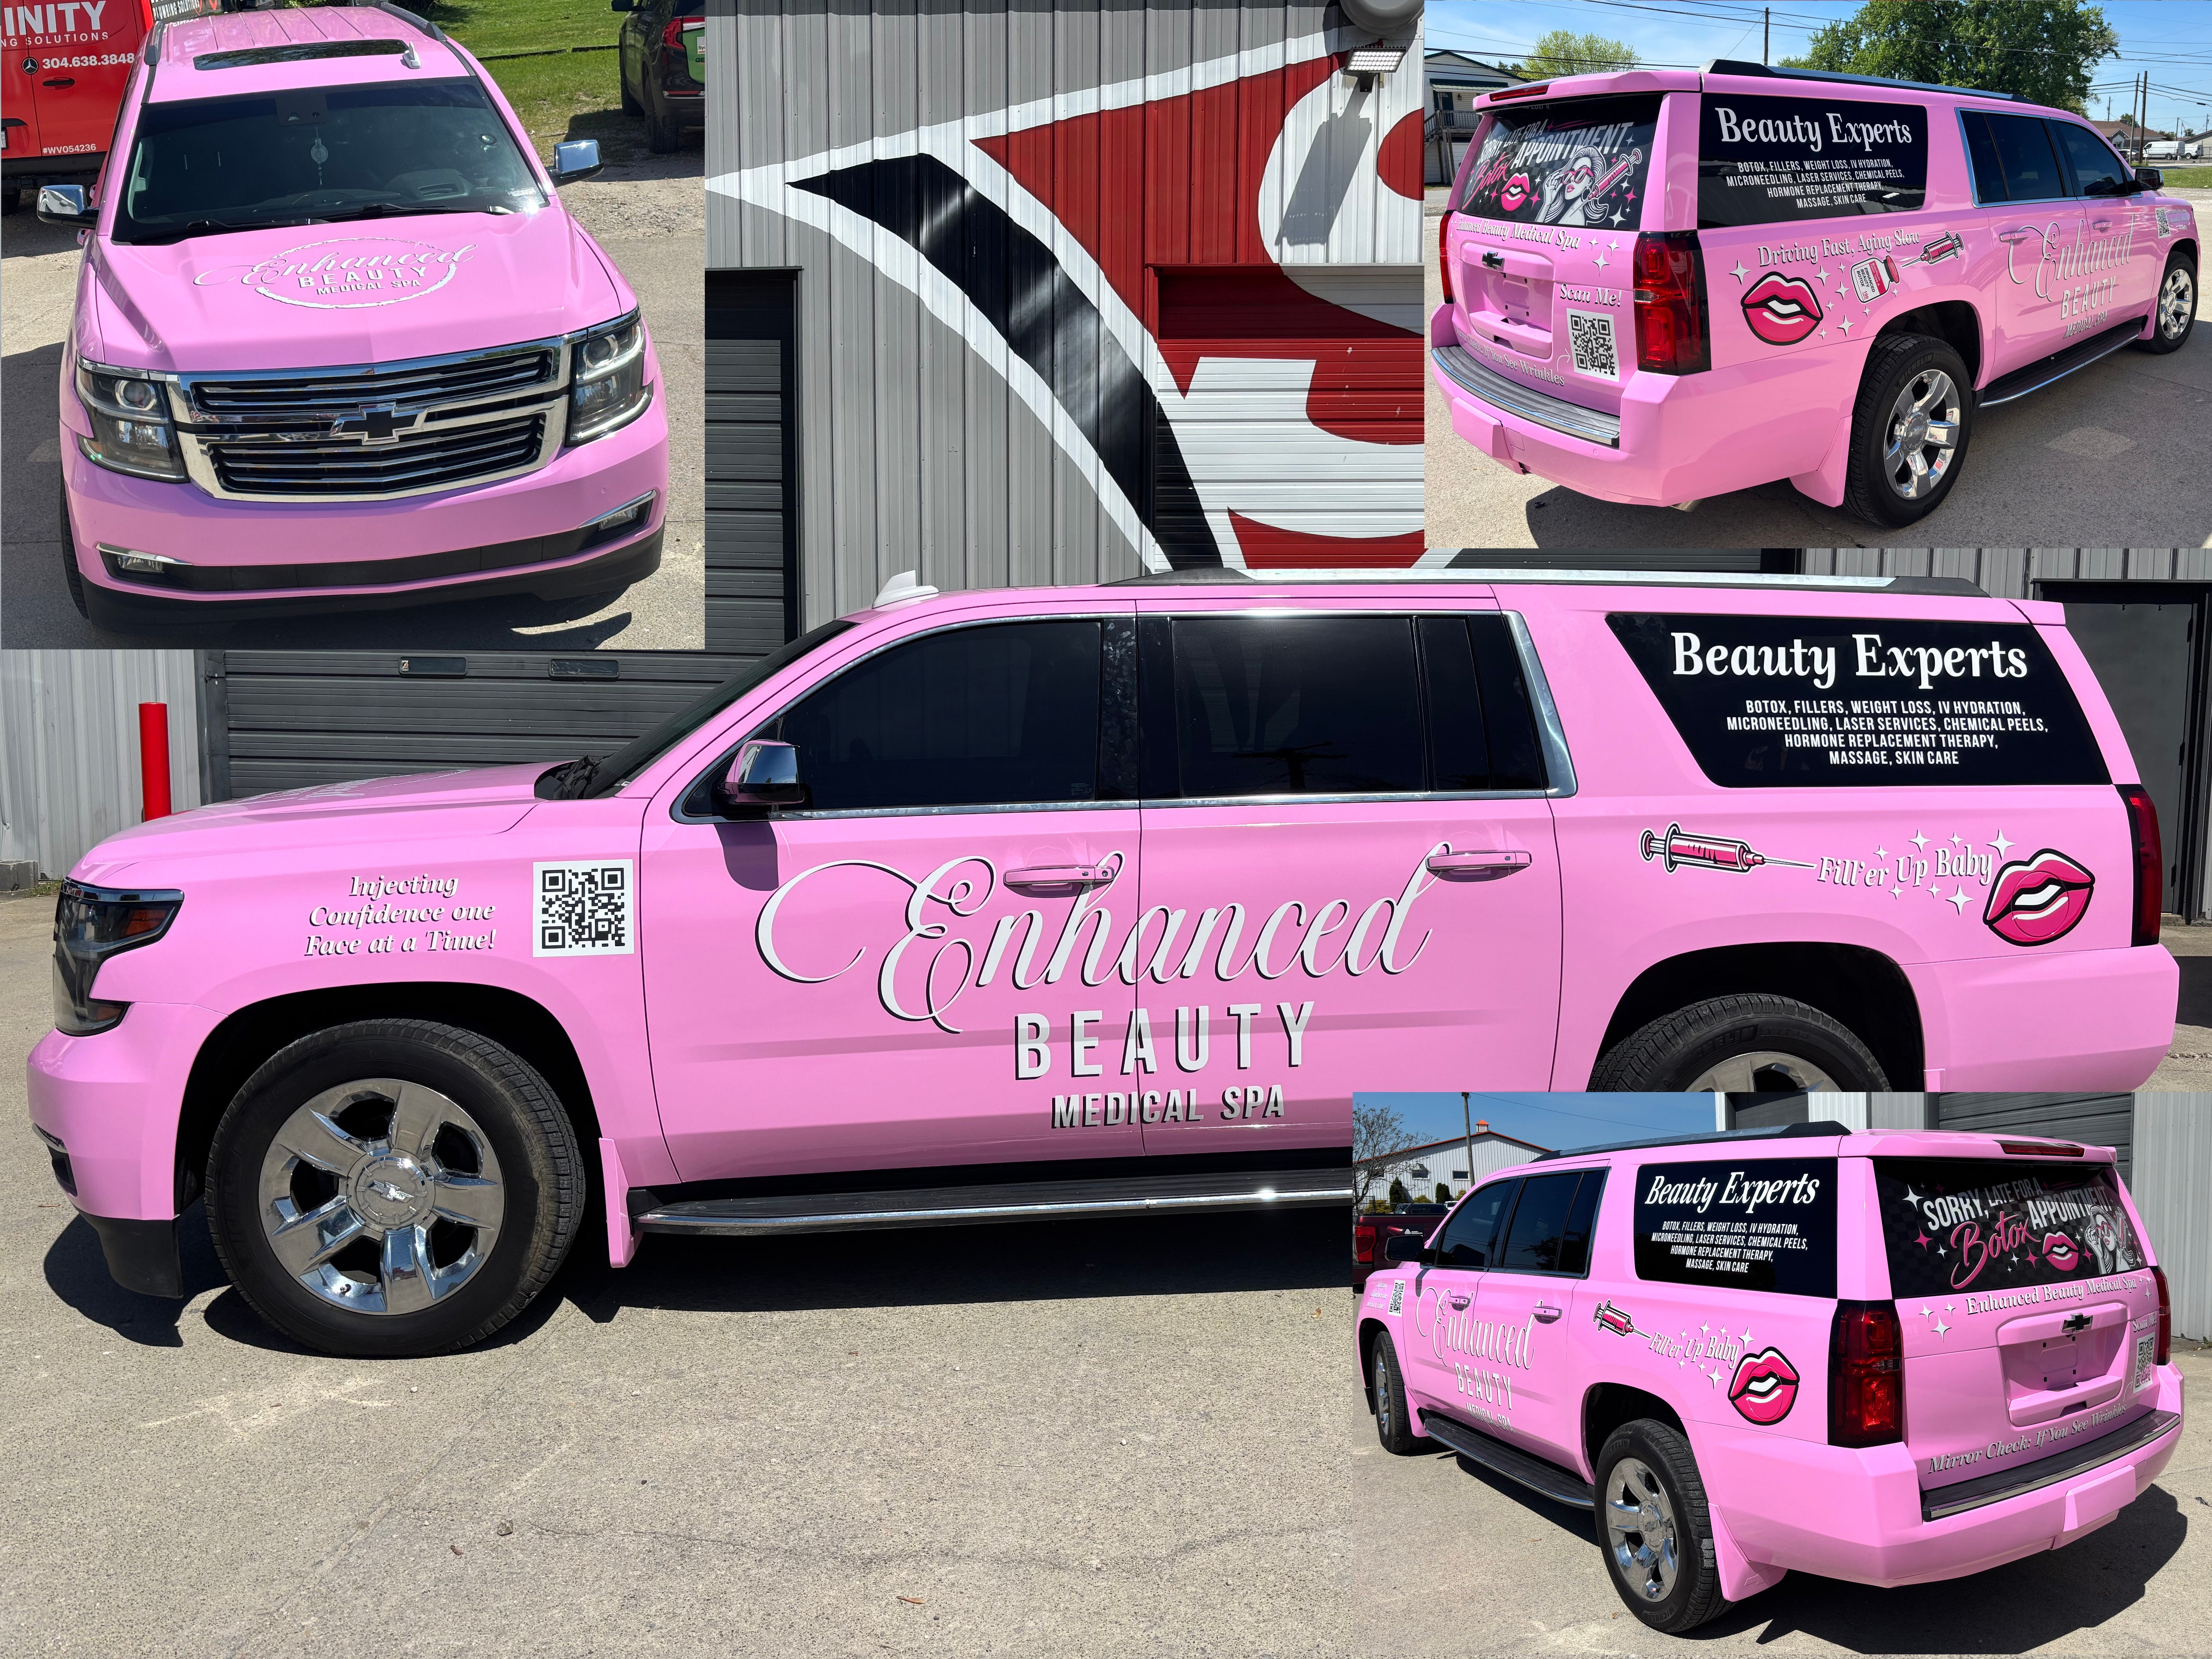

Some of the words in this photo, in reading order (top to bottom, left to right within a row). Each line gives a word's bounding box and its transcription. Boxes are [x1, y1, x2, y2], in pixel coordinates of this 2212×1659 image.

[153, 2, 177, 20] PLUMBING
[178, 0, 199, 14] SOLUTIONS
[26, 32, 109, 45] SOLUTIONS
[43, 53, 135, 69] 304.638.3848
[1503, 126, 1525, 148] LATE
[1520, 121, 1541, 141] FOR
[1538, 119, 1548, 136] A
[1715, 107, 1821, 152] Beauty
[1826, 113, 1912, 151] Experts
[43, 144, 96, 154] #WV054236
[1462, 151, 1514, 210] Botox
[1511, 122, 1634, 169] APPOINTMENT
[1726, 174, 1796, 187] MICRONEEDLING,
[1796, 173, 1820, 183] LASER
[1821, 172, 1855, 182] SERVICES,
[1855, 170, 1885, 179] CHEMICAL
[1885, 169, 1905, 178] PEELS,
[1737, 161, 1769, 174] BOTOX,
[1769, 161, 1803, 172] FILLERS,
[1803, 160, 1830, 170] WEIGHT
[1831, 160, 1850, 170] LOSS,
[1851, 160, 1857, 168] IV
[1858, 159, 1893, 168] HYDRATION,
[1767, 185, 1805, 198] HORMONE
[1806, 184, 1853, 195] REPLACEMENT
[1854, 181, 1884, 191] THERAPY,
[1796, 197, 1833, 208] MASSAGE,
[1834, 196, 1850, 205] SKIN
[1851, 194, 1867, 203] CARE
[1456, 218, 1483, 232] Enhanced
[1482, 220, 1510, 241] Beauty
[1510, 224, 1555, 244] Medical
[1556, 230, 1581, 251] Spa
[1758, 242, 1818, 267] Driving
[1822, 238, 1855, 258] Fast,
[1858, 233, 1892, 256] Aging
[1894, 229, 1920, 247] Slow
[193, 244, 478, 285] Enhanced
[2008, 213, 2136, 302] Enhanced
[299, 266, 426, 288] BEAUTY
[317, 283, 384, 295] MEDICAL
[392, 279, 421, 288] SPA
[1861, 269, 1869, 287] BEAUTY
[1864, 268, 1875, 292] ENHANCED
[1560, 284, 1590, 303] Scan
[1595, 288, 1622, 306] Me!
[2061, 276, 2116, 319] BEAUTY
[2063, 315, 2093, 339] MEDICAL
[2094, 310, 2107, 327] SPA
[1467, 334, 1483, 355] Check:
[1484, 345, 1491, 360] If
[1489, 349, 1503, 364] You
[1504, 354, 1518, 370] See
[1519, 359, 1565, 386] Wrinkles
[1671, 632, 1835, 689] Beauty
[1853, 634, 2028, 689] Experts
[1746, 701, 1792, 715] BOTOX,
[1794, 701, 1848, 715] FILLERS,
[1851, 701, 1899, 714] WEIGHT
[1902, 701, 1935, 716] LOSS,
[1938, 701, 1951, 714] IV
[1953, 701, 2026, 716] HYDRATION,
[1727, 717, 1833, 732] MICRONEEDLING,
[1835, 717, 1875, 730] LASER
[1877, 717, 1941, 733] SERVICES,
[1944, 718, 2005, 731] CHEMICAL
[2008, 718, 2049, 733] PEELS,
[1784, 734, 1846, 747] HORMONE
[1849, 734, 1936, 748] REPLACEMENT
[1939, 735, 1998, 750] THERAPY,
[1829, 750, 1893, 766] MASSAGE,
[1896, 751, 1925, 764] SKIN
[1927, 751, 1959, 764] CARE
[1897, 855, 1928, 887] Up
[1935, 845, 1993, 885] Baby
[349, 873, 459, 901] Injecting
[309, 903, 444, 930] Confidence
[452, 904, 495, 922] one
[304, 935, 361, 957] Face
[370, 935, 395, 953] at
[401, 938, 417, 952] a
[425, 929, 497, 952] Time!
[755, 841, 1453, 1034] Enhanced
[1015, 1001, 1315, 1080] BEAUTY
[1051, 1088, 1202, 1128] MEDICAL
[1220, 1084, 1285, 1119] SPA
[1645, 1175, 1718, 1213] Beauty
[1719, 1172, 1819, 1214] Experts
[1923, 1188, 1989, 1231] SORRY,
[1985, 1183, 2014, 1207] LATE
[2013, 1178, 2035, 1200] FOR
[2033, 1177, 2043, 1195] A
[1651, 1232, 1694, 1244] MICRONEEDLING,
[1696, 1234, 1714, 1244] LASER
[1714, 1235, 1746, 1247] SERVICES,
[1748, 1237, 1781, 1248] CHEMICAL
[1783, 1238, 1808, 1250] PEELS,
[1662, 1221, 1680, 1232] BOTOX,
[1682, 1222, 1705, 1233] FILLERS,
[1707, 1223, 1731, 1232] WEIGHT
[1730, 1223, 1747, 1234] LOSS,
[1749, 1223, 1757, 1233] IV
[1758, 1224, 1798, 1236] HYDRATION,
[1950, 1211, 2041, 1290] Botox
[2026, 1186, 2112, 1230] APPOINTMENT
[1671, 1246, 1698, 1256] HORMONE
[1698, 1247, 1741, 1259] REPLACEMENT
[1743, 1249, 1773, 1262] THERAPY,
[1686, 1258, 1714, 1271] MASSAGE,
[1716, 1261, 1731, 1271] SKIN
[1732, 1261, 1749, 1273] CARE
[1966, 1287, 2040, 1315] Enhanced
[2044, 1285, 2084, 1302] Beauty
[2085, 1278, 2122, 1295] Medical
[2122, 1276, 2137, 1293] Spa
[1416, 1286, 1543, 1369] Enhanced
[2133, 1319, 2148, 1333] Scan
[1684, 1338, 1704, 1362] Up
[1705, 1336, 1740, 1369] Baby
[1455, 1362, 1511, 1410] BEAUTY
[1466, 1402, 1499, 1428] MEDICAL
[1497, 1413, 1516, 1434] SPA
[1928, 1453, 1982, 1474] Mirror
[1985, 1435, 2032, 1459] Check:
[2035, 1431, 2047, 1449] If
[2049, 1425, 2068, 1442] You
[2071, 1419, 2088, 1435] See
[2091, 1403, 2126, 1427] Wrinkles
